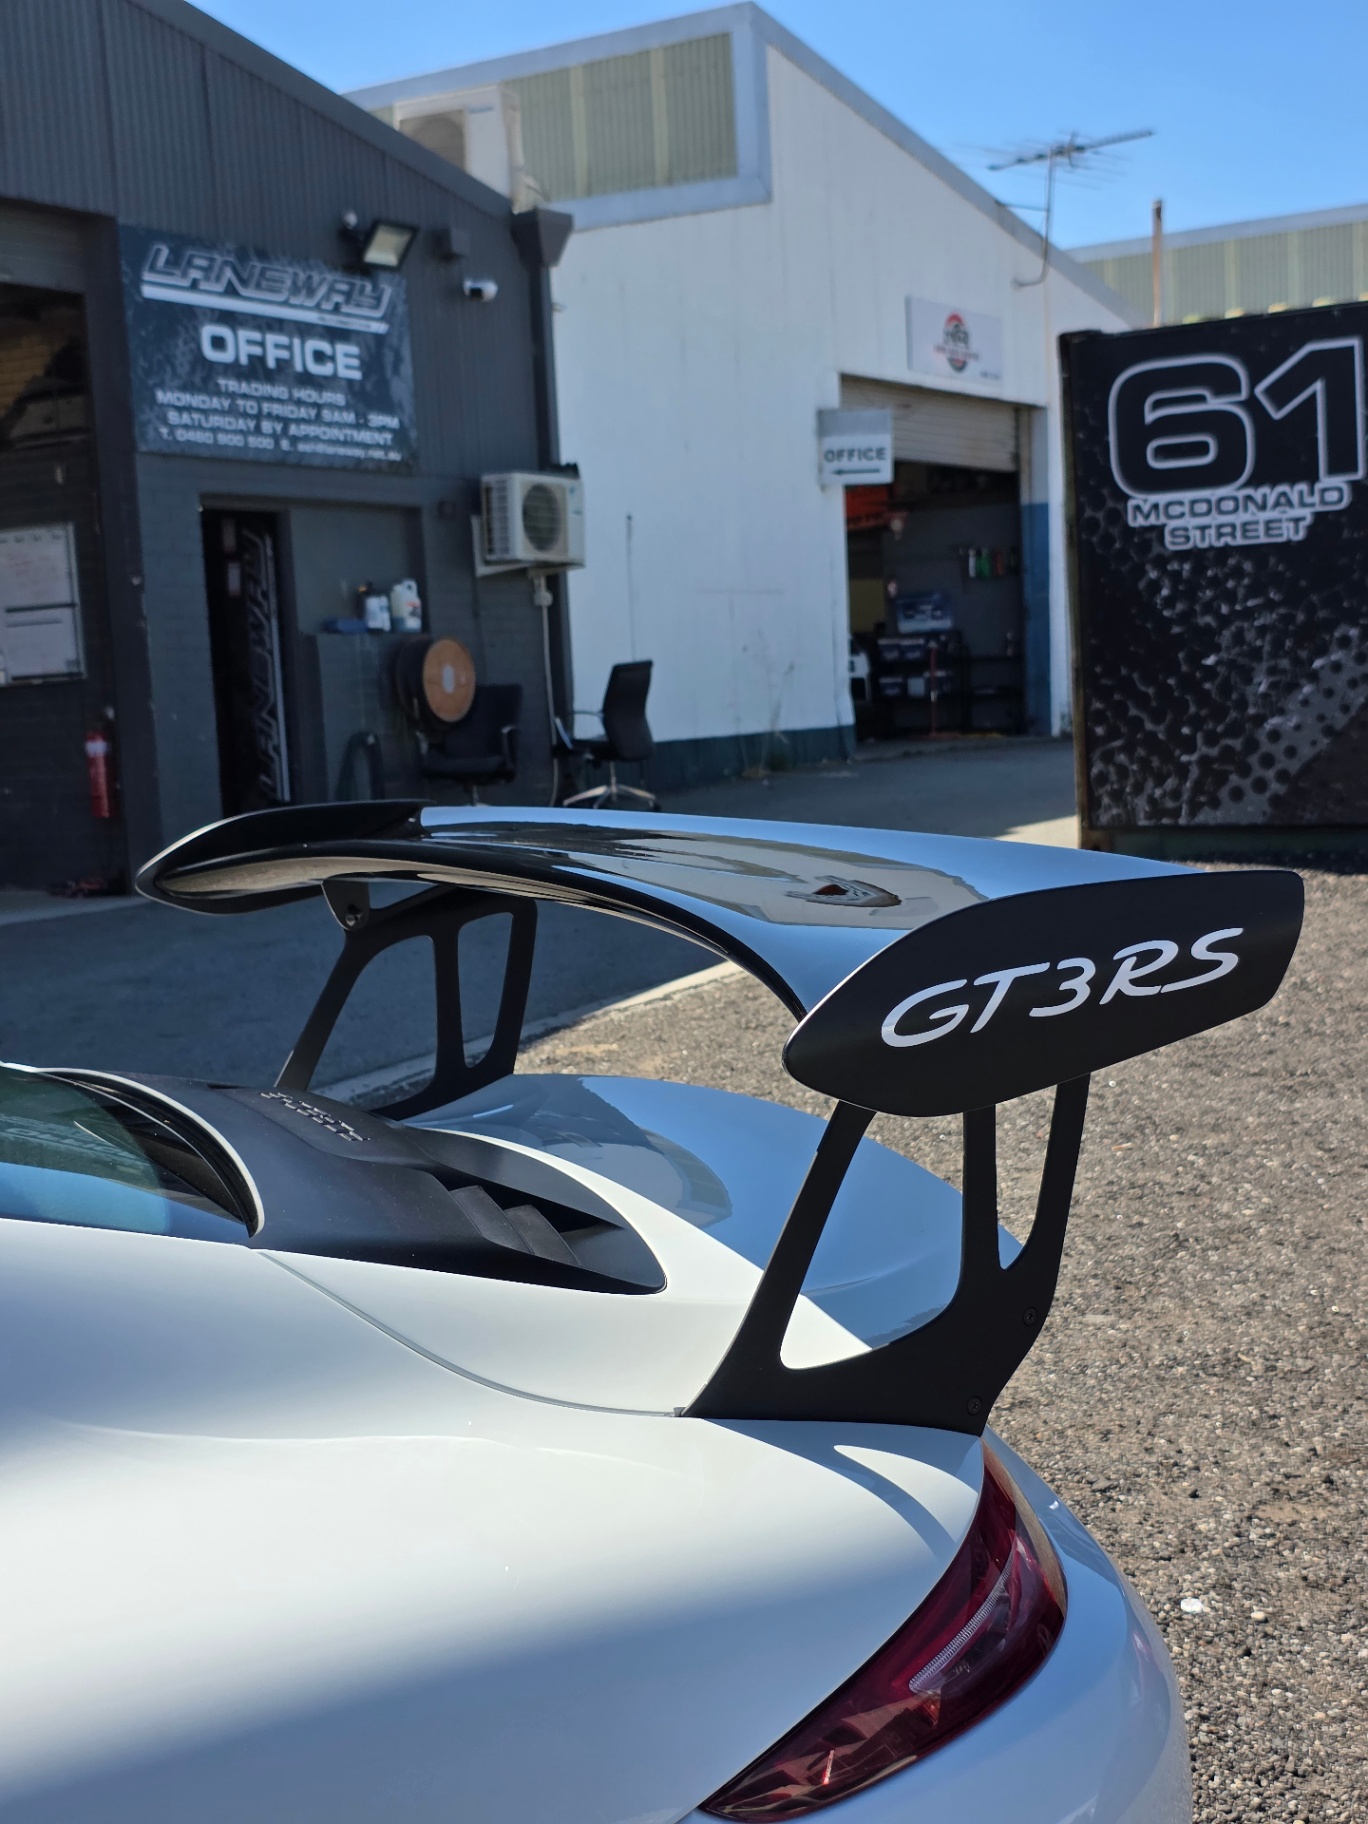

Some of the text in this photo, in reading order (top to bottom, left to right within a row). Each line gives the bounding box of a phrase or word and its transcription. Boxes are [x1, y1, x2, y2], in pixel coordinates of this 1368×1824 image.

[141, 245, 390, 318] LANEWAY
[201, 324, 362, 380] OFFICE
[155, 389, 232, 413] MONDAY
[236, 400, 258, 415] TO
[261, 403, 317, 423] FRIDAY
[217, 378, 346, 406] TRADING HOURS
[167, 410, 393, 446] SATURDAY BY APPOINTMENT
[1108, 336, 1366, 498] 61
[822, 446, 888, 464] OFFICE
[1129, 483, 1350, 526] MCDONALD
[1166, 513, 1312, 549] STREET
